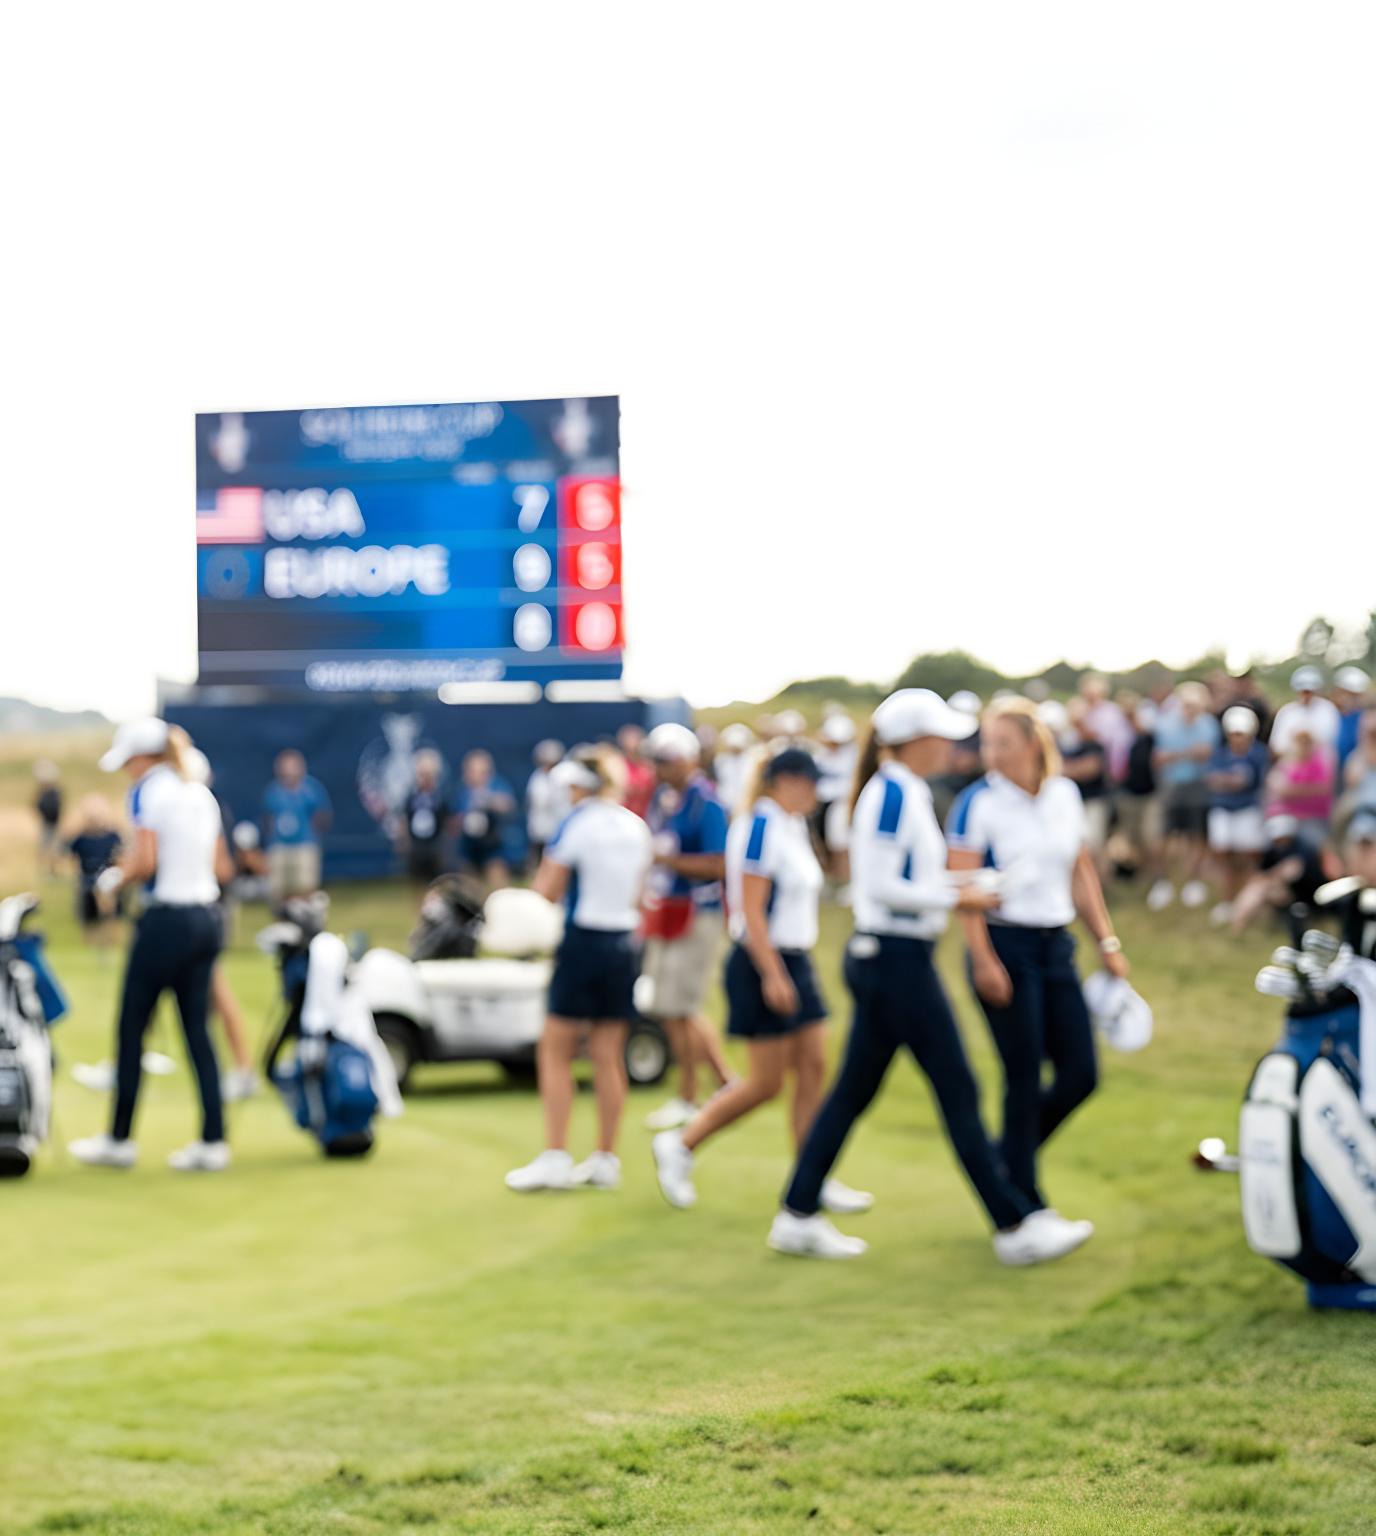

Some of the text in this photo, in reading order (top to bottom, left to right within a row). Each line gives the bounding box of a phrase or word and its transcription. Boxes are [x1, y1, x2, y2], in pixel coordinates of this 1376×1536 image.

[263, 487, 366, 541] USA
[512, 484, 550, 533] 7
[264, 543, 451, 598] EUROPE
